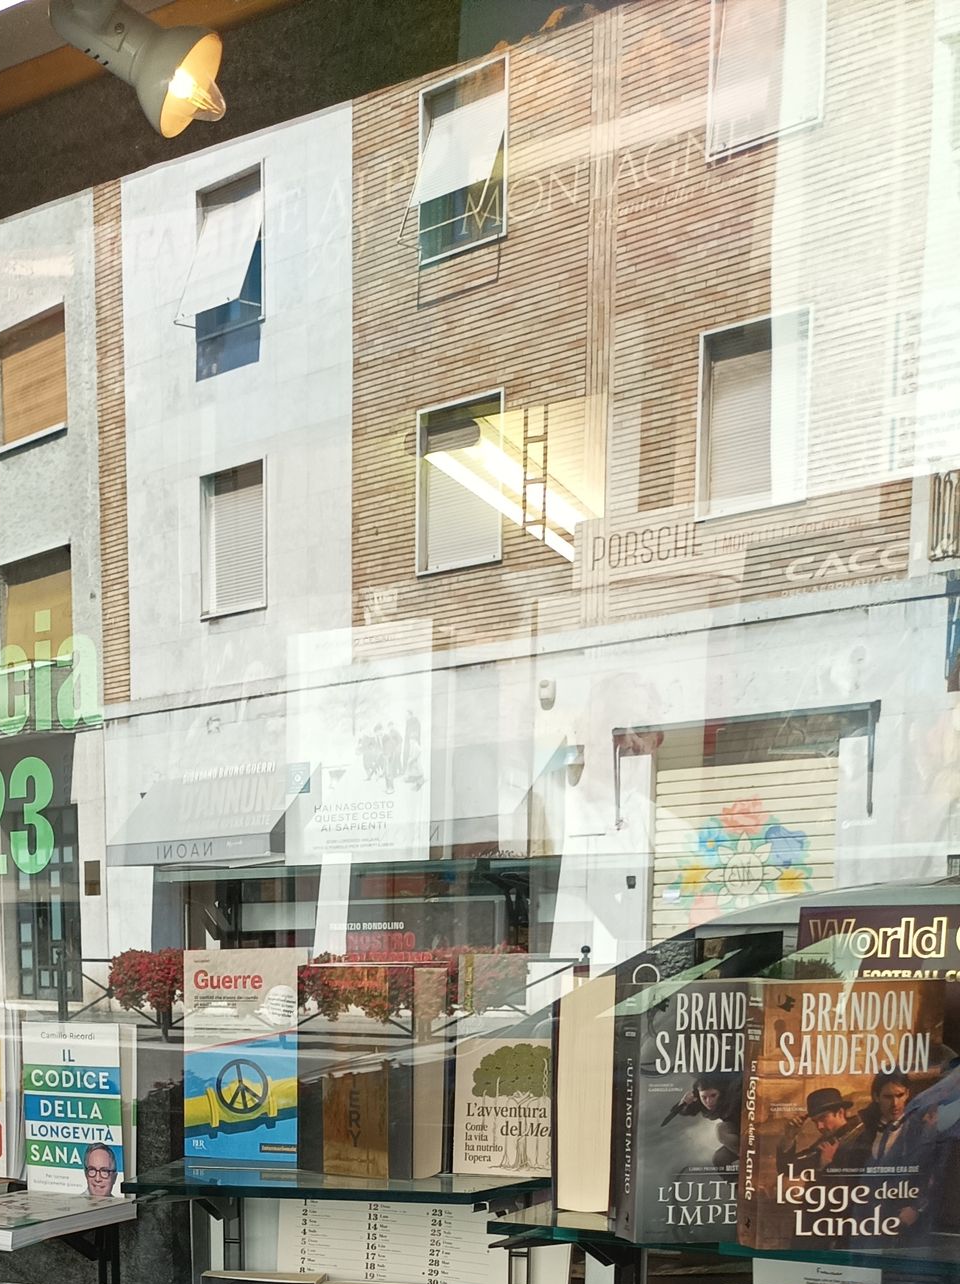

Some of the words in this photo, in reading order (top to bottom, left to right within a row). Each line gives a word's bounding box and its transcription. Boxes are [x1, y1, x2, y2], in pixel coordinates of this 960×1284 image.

[360, 811, 394, 821] COSE
[809, 917, 948, 958] World
[193, 969, 263, 990] Guerre
[801, 991, 914, 1032] BRANDON
[41, 1031, 67, 1040] Camillo
[69, 1031, 95, 1040] Ricordi
[62, 1048, 75, 1062] IL
[779, 1032, 930, 1077] SANDERSON
[31, 1069, 110, 1089] CODICE
[40, 1099, 103, 1119] DELLA
[466, 1101, 547, 1119] L'avventura
[31, 1122, 114, 1141] LONGEVITÀ
[465, 1123, 488, 1132] Come
[465, 1133, 474, 1141] la
[475, 1132, 488, 1141] vita
[500, 1120, 523, 1137] del
[30, 1144, 81, 1164] SANA
[465, 1143, 474, 1151] ha
[476, 1143, 503, 1152] nutrito
[465, 1152, 491, 1163] l'opera
[788, 1163, 816, 1182] La
[776, 1172, 870, 1212] legge
[874, 1181, 919, 1199] delle
[431, 1209, 443, 1217] 23
[794, 1204, 901, 1237] Lande
[431, 1219, 442, 1227] 24
